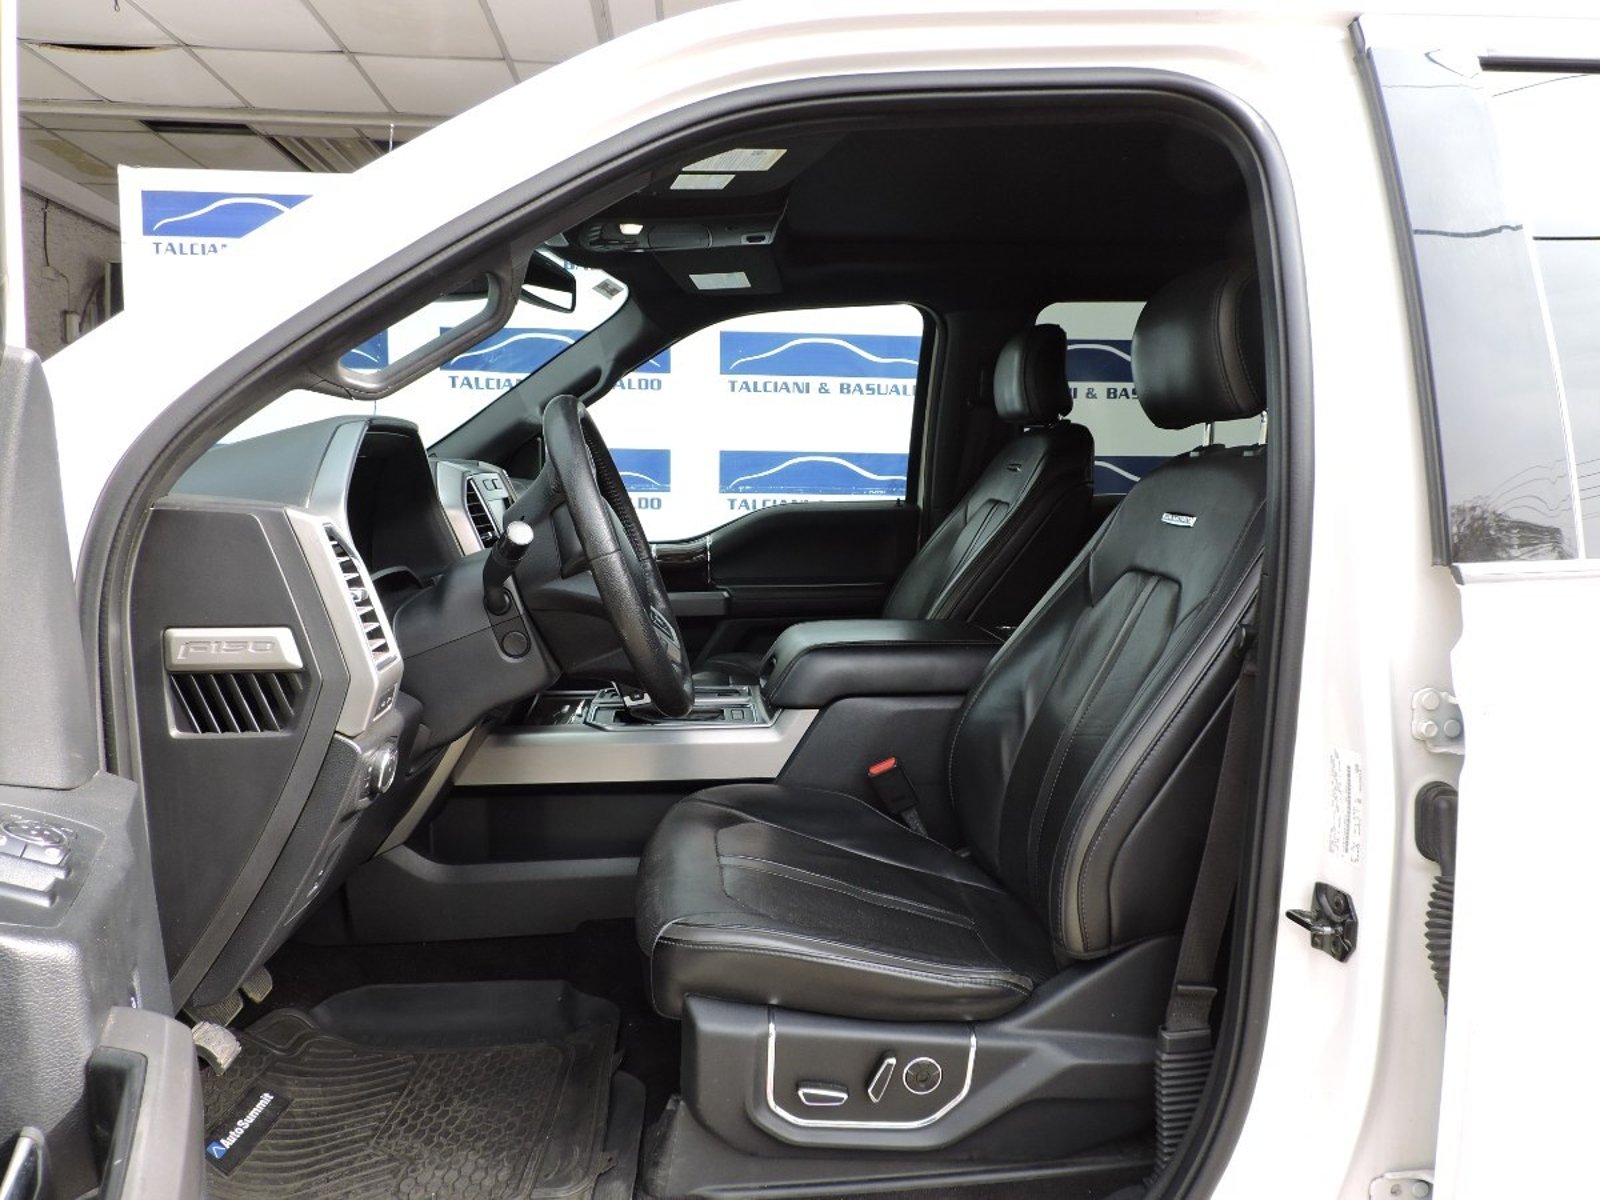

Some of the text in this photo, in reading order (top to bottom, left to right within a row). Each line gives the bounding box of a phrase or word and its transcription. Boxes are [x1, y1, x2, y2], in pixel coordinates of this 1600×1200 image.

[728, 380, 810, 394] TALCIANI
[818, 382, 831, 394] &
[1086, 387, 1098, 399] &
[220, 1092, 275, 1150] AutoSummit
